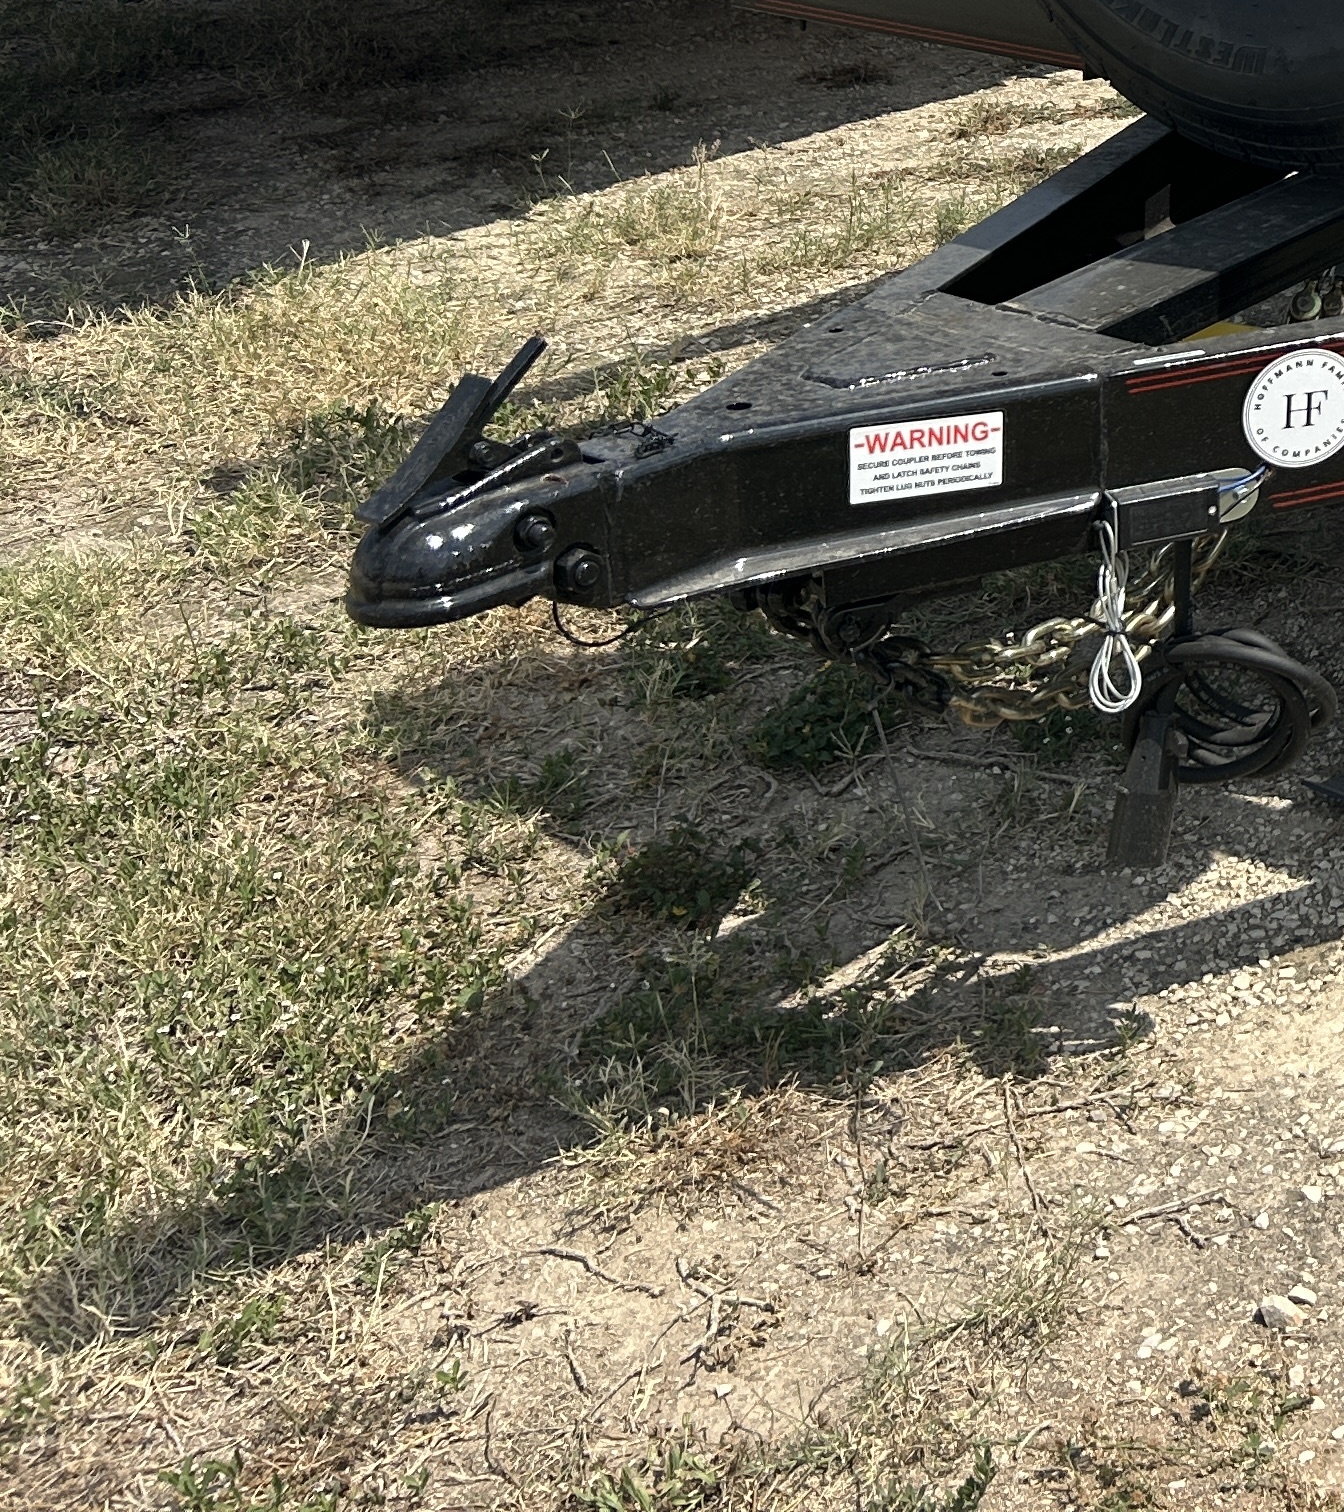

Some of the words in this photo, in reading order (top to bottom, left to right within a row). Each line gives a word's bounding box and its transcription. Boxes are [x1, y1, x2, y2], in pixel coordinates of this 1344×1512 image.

[1254, 359, 1315, 410] HOFFMANN
[1281, 389, 1329, 430] HF
[1256, 428, 1270, 443] OF
[857, 460, 890, 471] SECURE
[891, 455, 930, 467] COUPLER
[931, 450, 963, 462] BEFORE
[965, 447, 997, 458] TOWING
[872, 472, 891, 481] AND
[892, 467, 918, 479] LATCH
[920, 464, 950, 476] SAFETY
[951, 461, 981, 472] CHAINS
[860, 484, 895, 495] TIGHTEN
[895, 482, 913, 491] LUG
[914, 479, 936, 489] NUTS
[937, 471, 994, 486] PERIODICALLY
